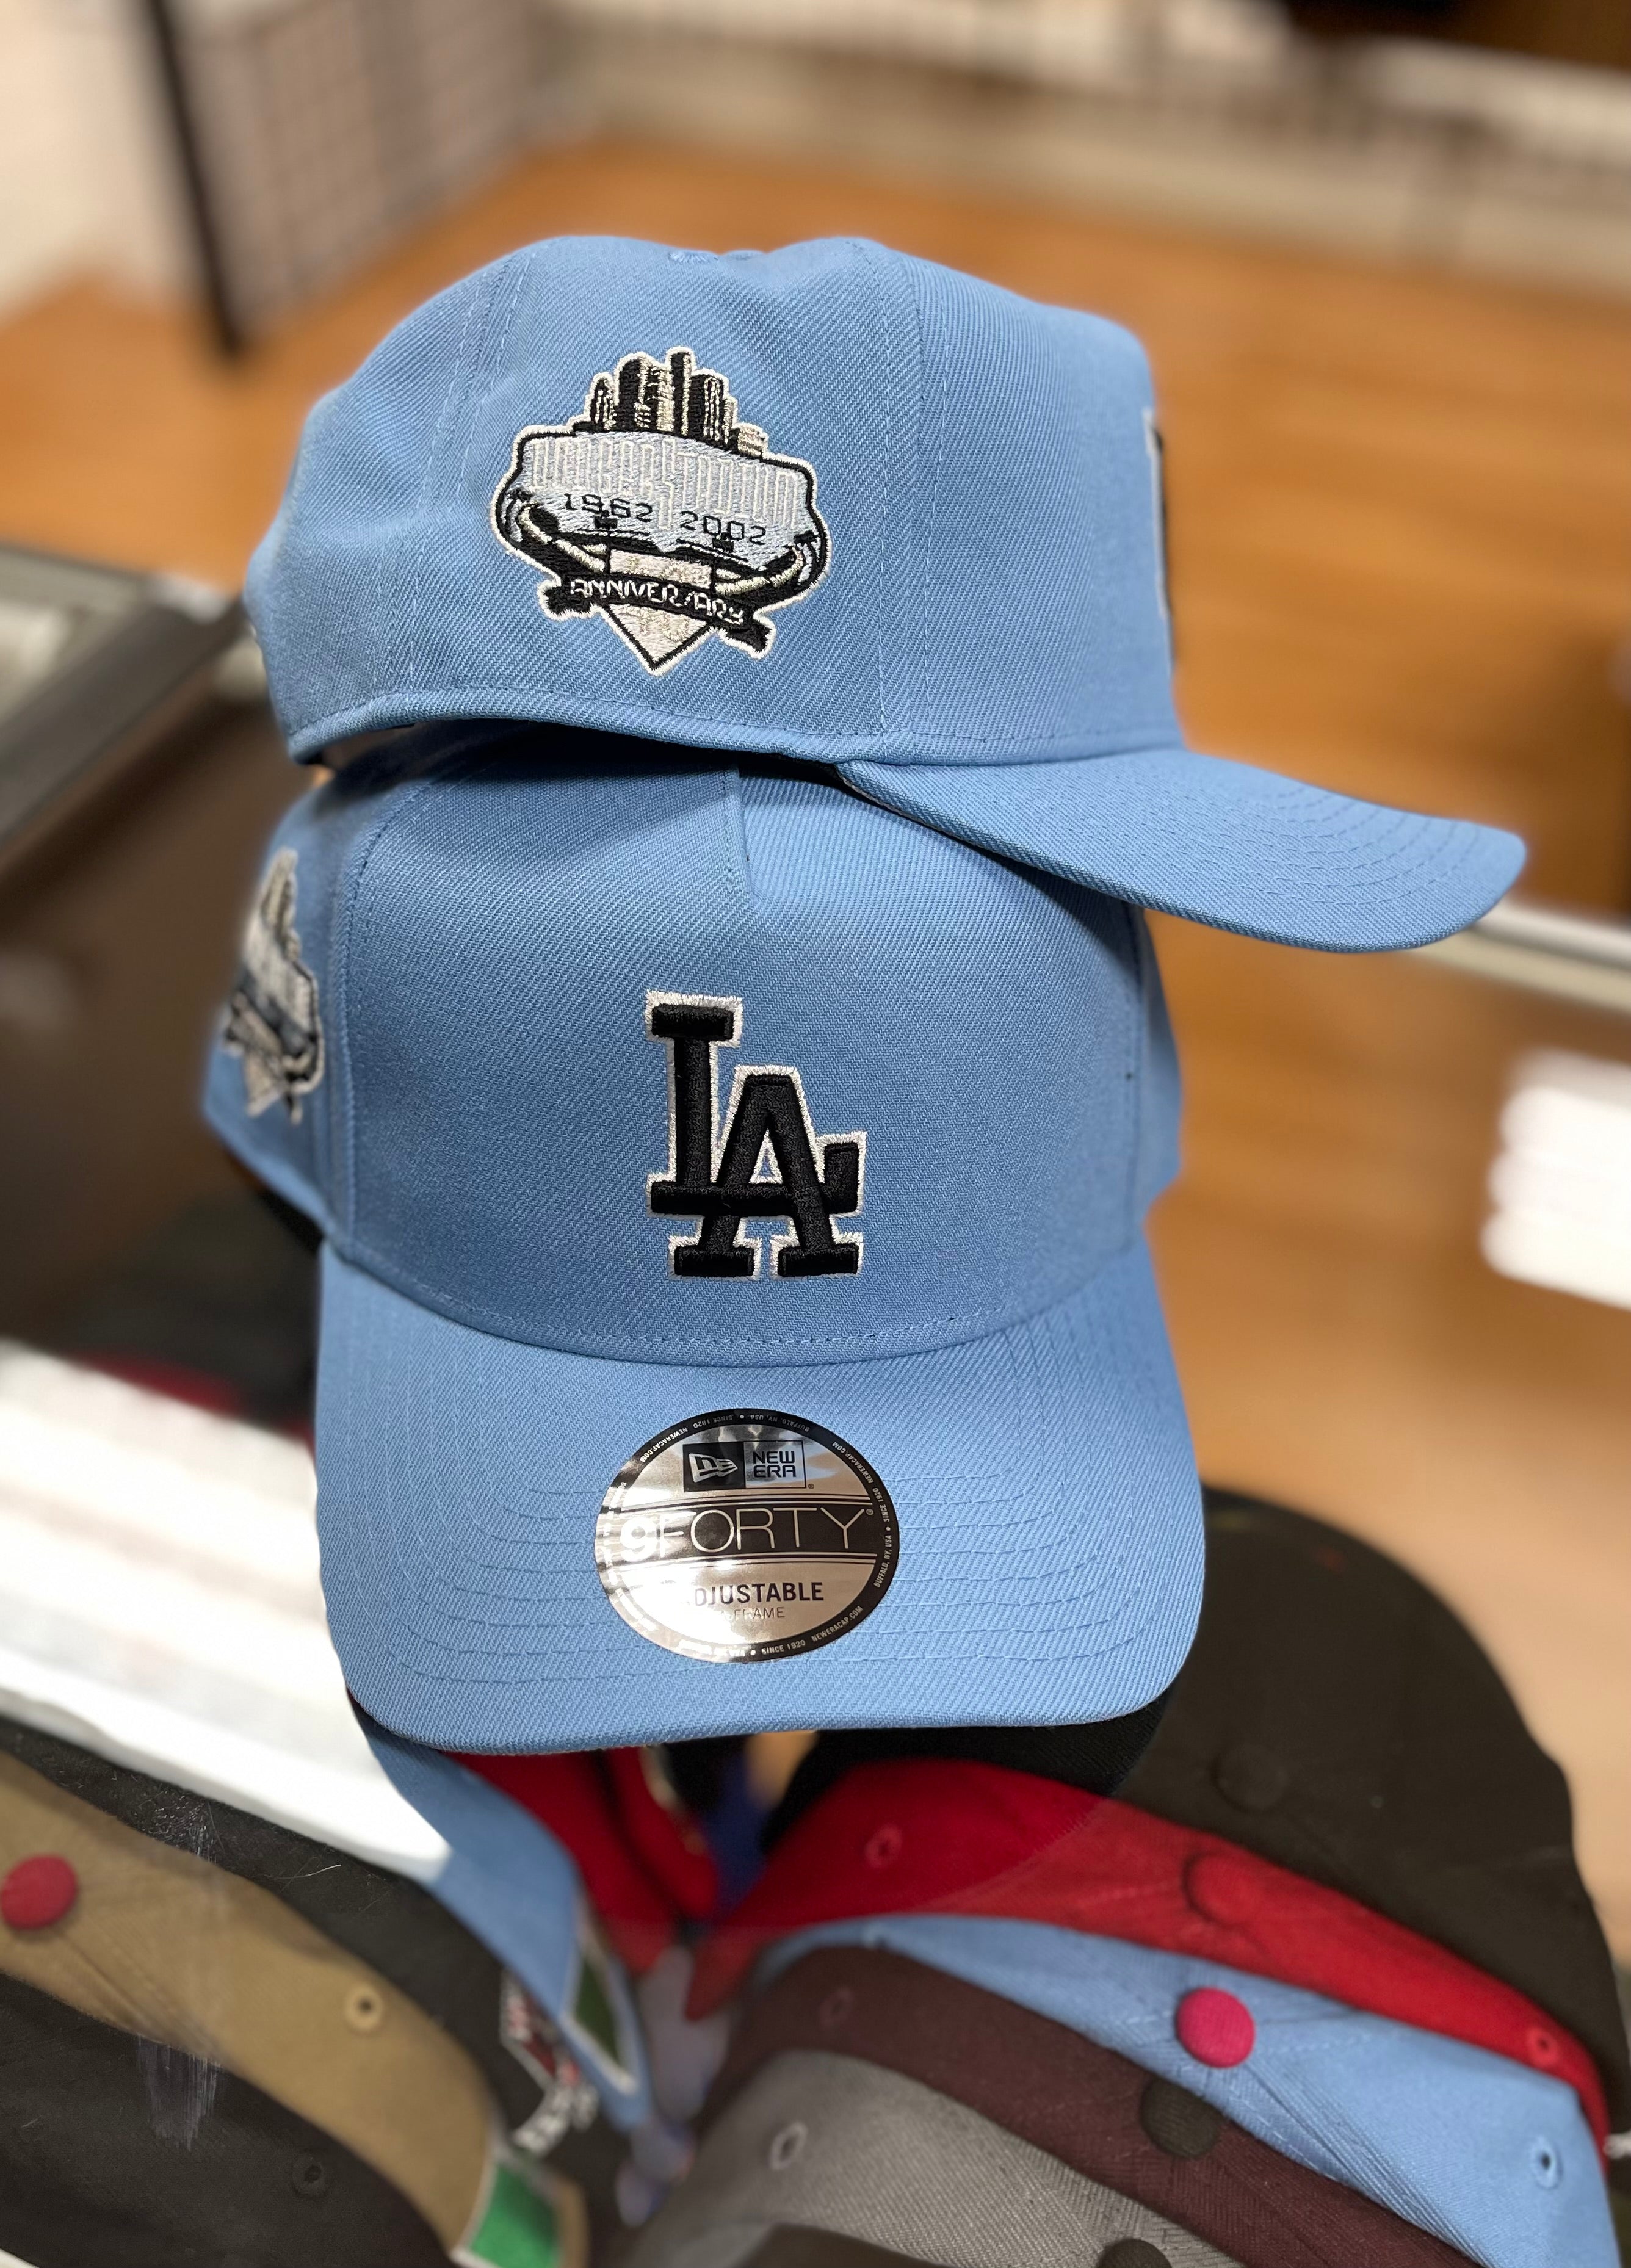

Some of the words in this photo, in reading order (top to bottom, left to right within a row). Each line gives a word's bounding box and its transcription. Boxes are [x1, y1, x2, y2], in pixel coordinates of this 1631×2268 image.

[564, 493, 653, 523] 1962
[679, 511, 767, 545] 2002
[646, 989, 867, 1279] LA
[753, 1451, 795, 1464] NEW
[753, 1465, 796, 1478] ERA
[680, 1581, 824, 1606] DJUSTABLE
[787, 1639, 806, 1650] 1920
